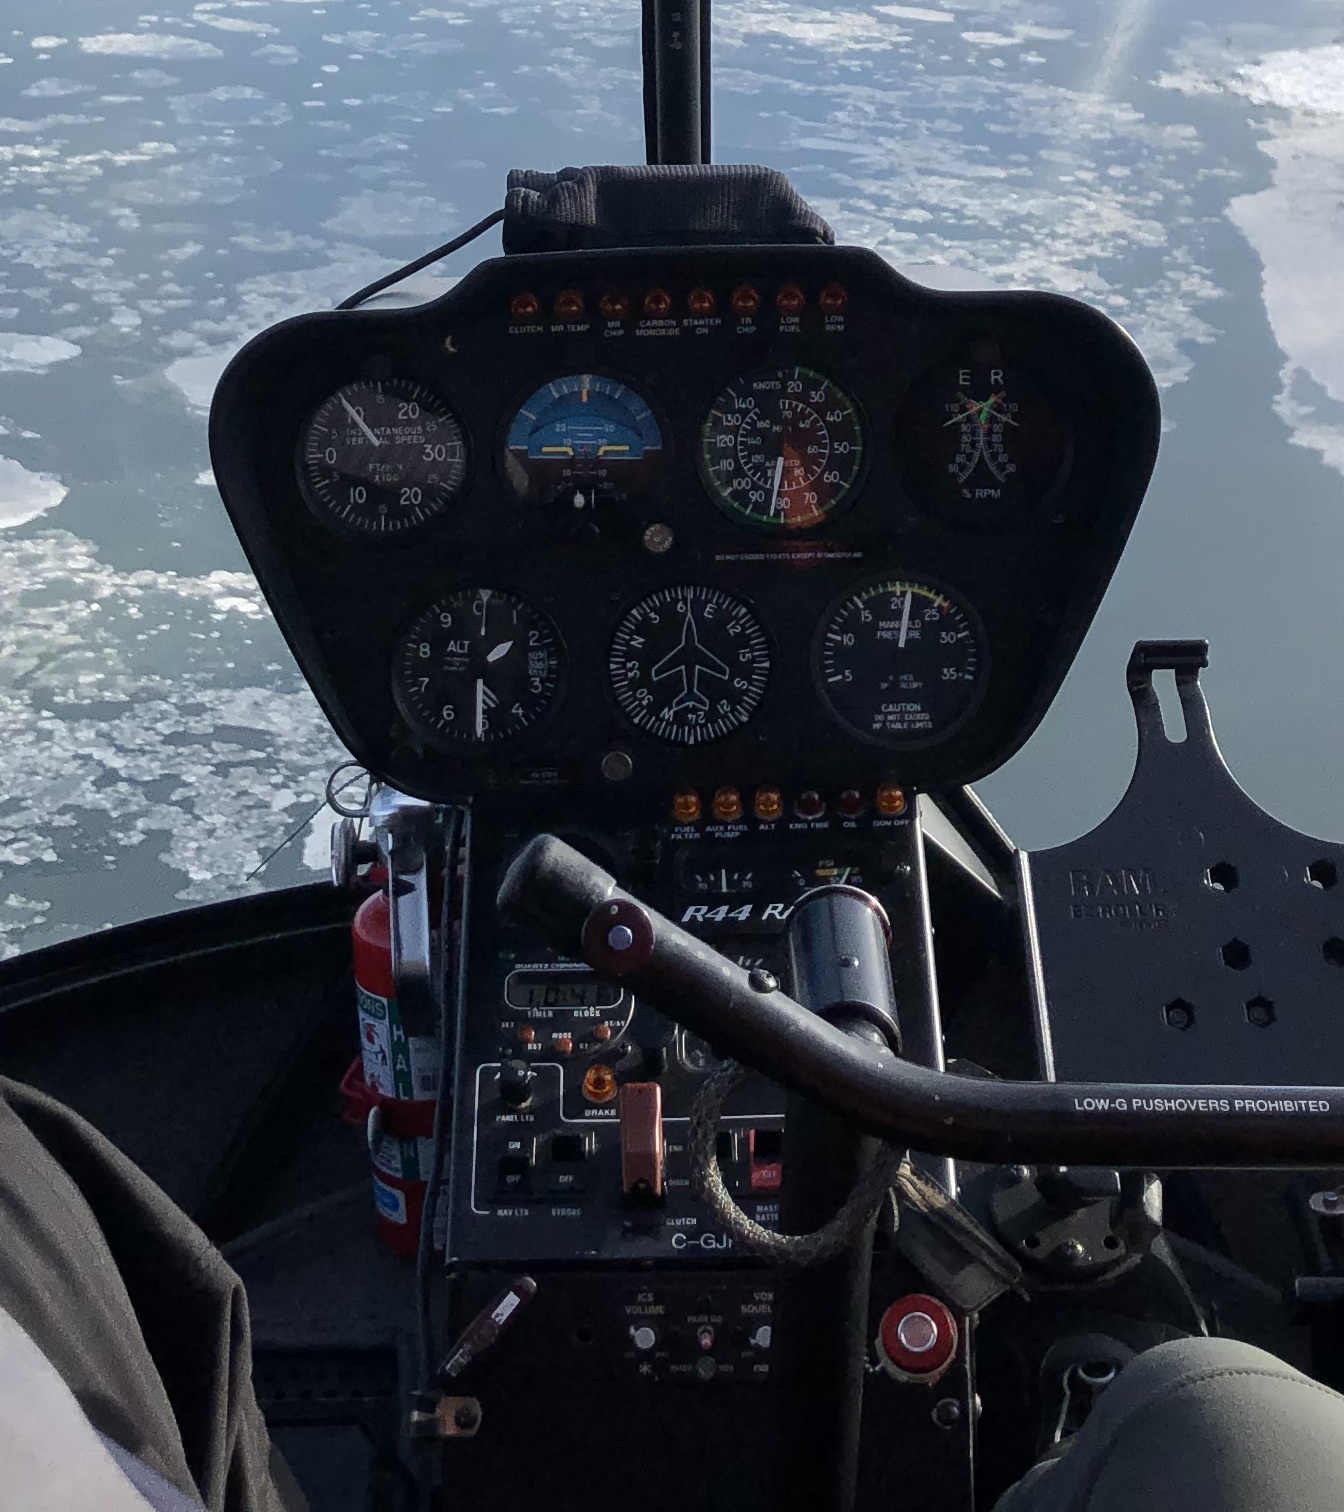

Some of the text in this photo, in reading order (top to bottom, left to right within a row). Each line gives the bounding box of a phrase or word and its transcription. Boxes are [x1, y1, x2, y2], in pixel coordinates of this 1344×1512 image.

[639, 319, 676, 327] CARBON
[682, 318, 722, 326] STARTER
[780, 316, 800, 324] LOW
[509, 325, 544, 333] CLUTCH
[567, 324, 590, 332] TEMP
[604, 330, 624, 338] CHIP
[636, 328, 680, 336] MONOXIDE
[736, 326, 756, 334] CHIP
[825, 324, 844, 332] RPM
[959, 370, 971, 386] E
[990, 370, 1004, 385] R
[753, 381, 782, 390] KNOTS
[788, 381, 802, 392] 20
[809, 390, 825, 402] 30
[736, 397, 754, 408] 140
[398, 402, 420, 420] 20
[826, 410, 842, 422] 40
[722, 414, 742, 426] 130
[756, 420, 770, 428] 160
[799, 420, 810, 428] 40
[395, 435, 426, 444] SPEED
[716, 435, 734, 447] 120
[748, 436, 762, 446] 140
[422, 444, 446, 461] 30
[808, 445, 818, 454] 60
[834, 442, 850, 454] 50
[326, 447, 336, 464] 0
[752, 454, 765, 463] 120
[720, 460, 734, 470] 110
[563, 468, 572, 476] 10
[598, 468, 608, 476] 10
[794, 467, 804, 476] 80
[824, 472, 840, 483] 60
[732, 478, 752, 489] 100
[350, 486, 367, 504] 10
[400, 487, 422, 505] 20
[748, 490, 764, 502] 90
[804, 492, 818, 504] 70
[976, 488, 1002, 499] RPM
[776, 497, 790, 510] 80
[676, 600, 686, 612] 6
[704, 604, 718, 618] E
[440, 612, 452, 628] 9
[512, 610, 517, 624] 1
[648, 612, 660, 624] 3
[860, 610, 872, 622] 15
[924, 608, 940, 621] 25
[726, 620, 742, 637] 12
[528, 630, 540, 646] 2
[630, 634, 646, 648] N
[843, 633, 854, 646] 10
[940, 632, 956, 644] 30
[419, 642, 430, 658] 8
[446, 640, 471, 653] ALT
[738, 648, 752, 662] 15
[626, 660, 640, 678] 33
[941, 668, 956, 680] 35
[844, 670, 852, 682] 5
[418, 678, 430, 692] 7
[530, 678, 542, 693] 3
[734, 678, 748, 690] S
[636, 688, 654, 706] 30
[442, 704, 454, 720] 6
[511, 702, 524, 716] 4
[716, 699, 731, 714] 21
[881, 702, 921, 712] CAUTION
[660, 706, 674, 722] W
[688, 712, 706, 724] 24
[671, 832, 701, 840] FILTER
[681, 904, 754, 922] R44
[1074, 1098, 1330, 1112] LOW-G PUSHOVERS PROHIBITED
[496, 1114, 520, 1122] PANEL
[584, 1108, 616, 1117] BRAKE
[508, 1141, 521, 1149] ON
[558, 1174, 575, 1183] OFF
[497, 1208, 529, 1217] NAV LTS
[551, 1208, 582, 1216] STROBE
[756, 1204, 778, 1213] MAST
[666, 1217, 697, 1226] CLUTCH
[637, 1292, 654, 1302] ICS
[753, 1291, 774, 1302] VOX
[624, 1305, 666, 1315] VOLUME
[740, 1304, 772, 1314] SQUEL
